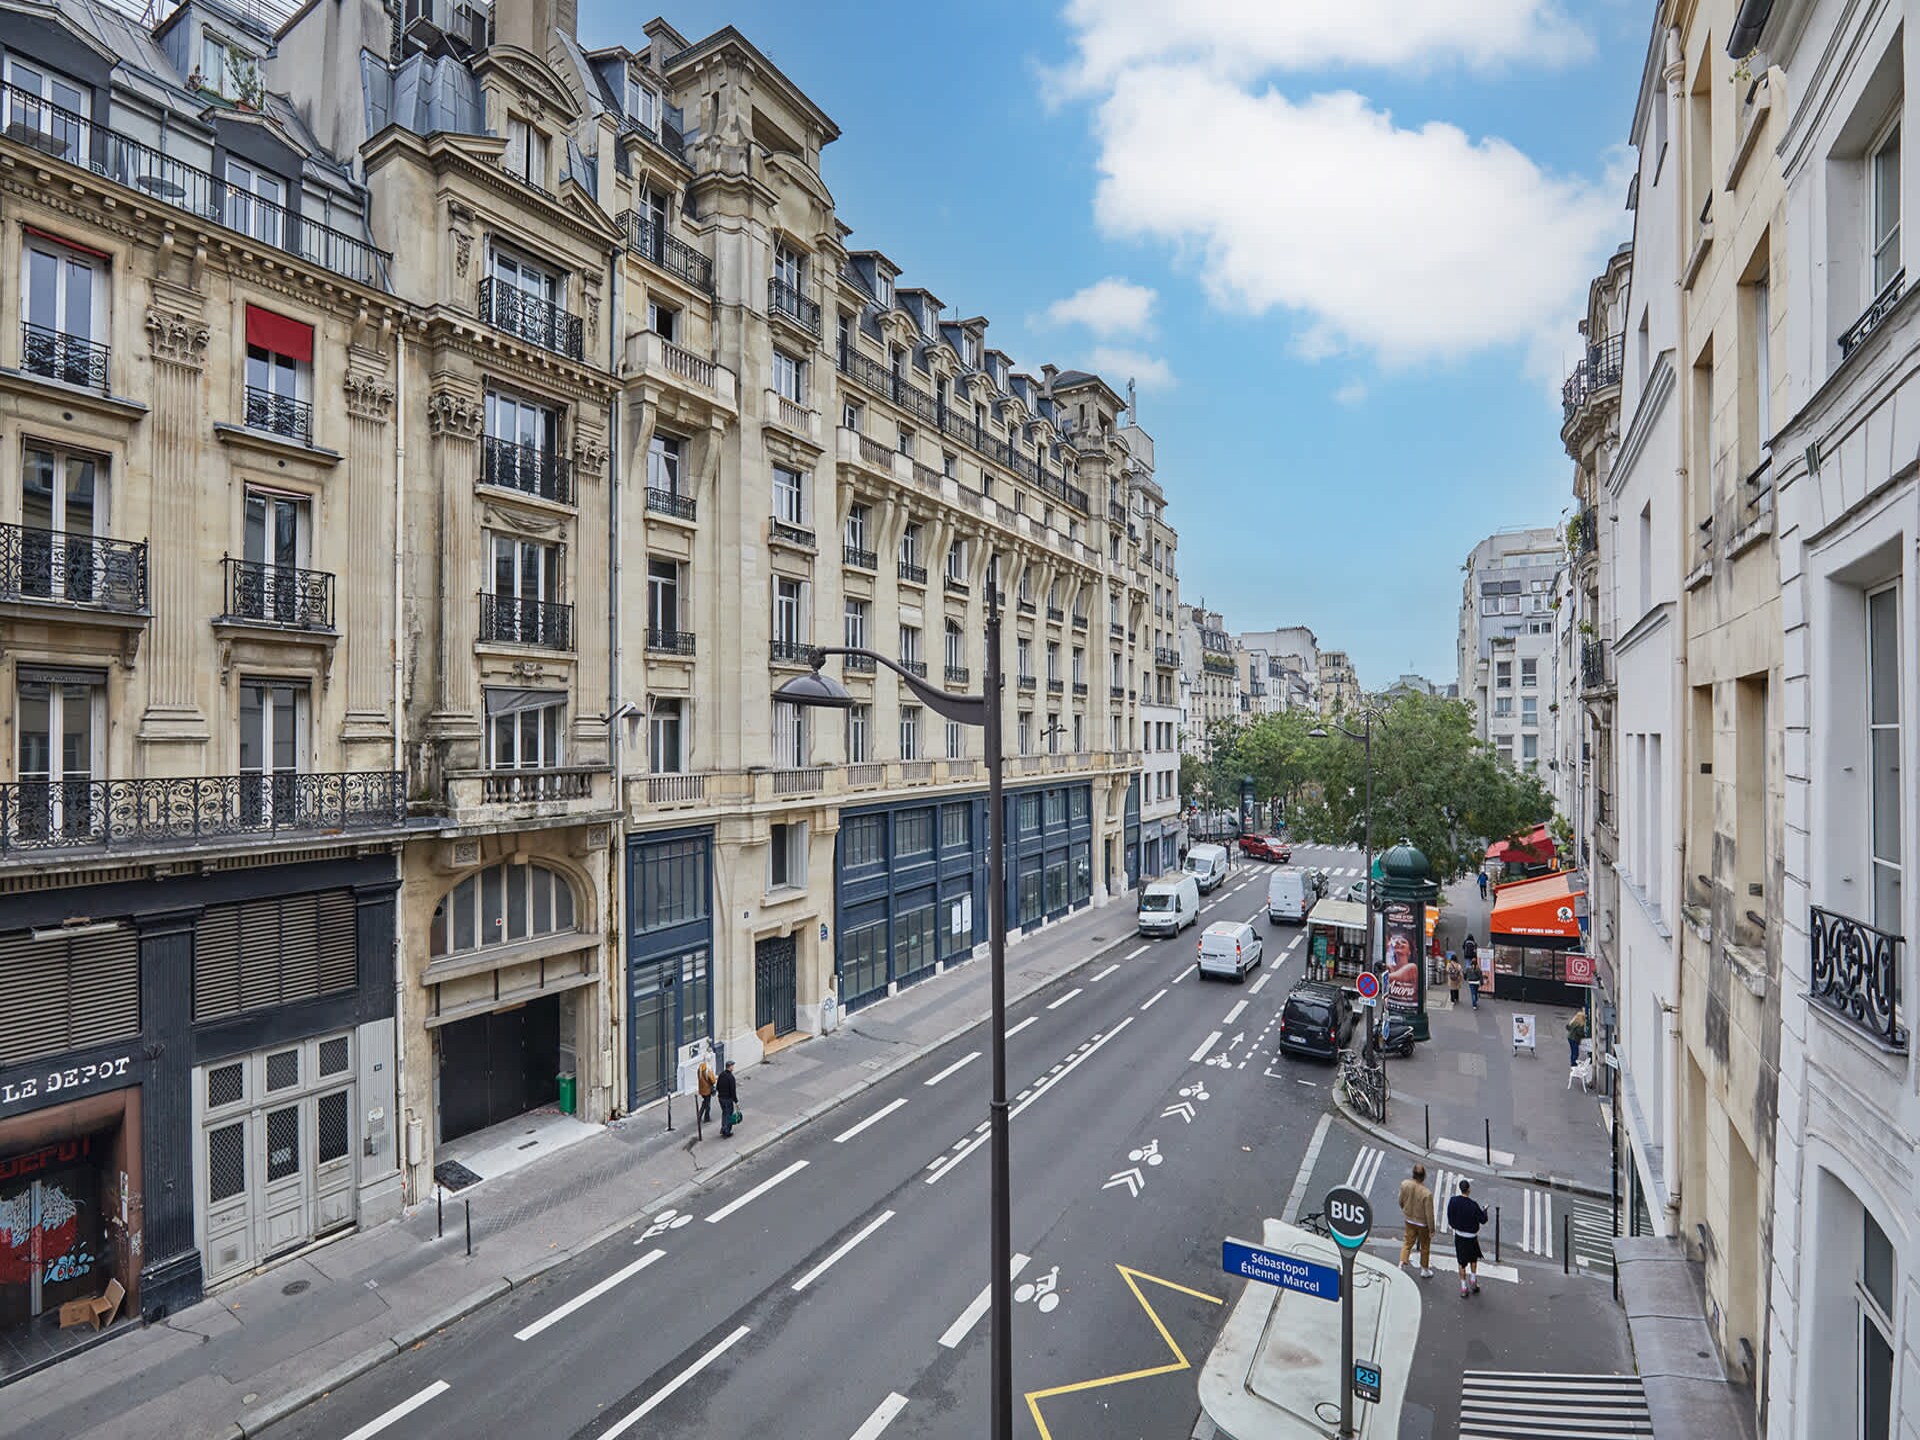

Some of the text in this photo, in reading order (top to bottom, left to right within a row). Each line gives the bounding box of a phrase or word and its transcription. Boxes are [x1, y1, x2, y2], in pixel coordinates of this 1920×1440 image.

[2, 1056, 130, 1104] LE DEPOT
[1331, 1200, 1365, 1225] BUS
[1241, 1261, 1320, 1292] Étienne Marcel
[1251, 1252, 1309, 1277] Sébastopol
[1359, 1368, 1376, 1384] 29
